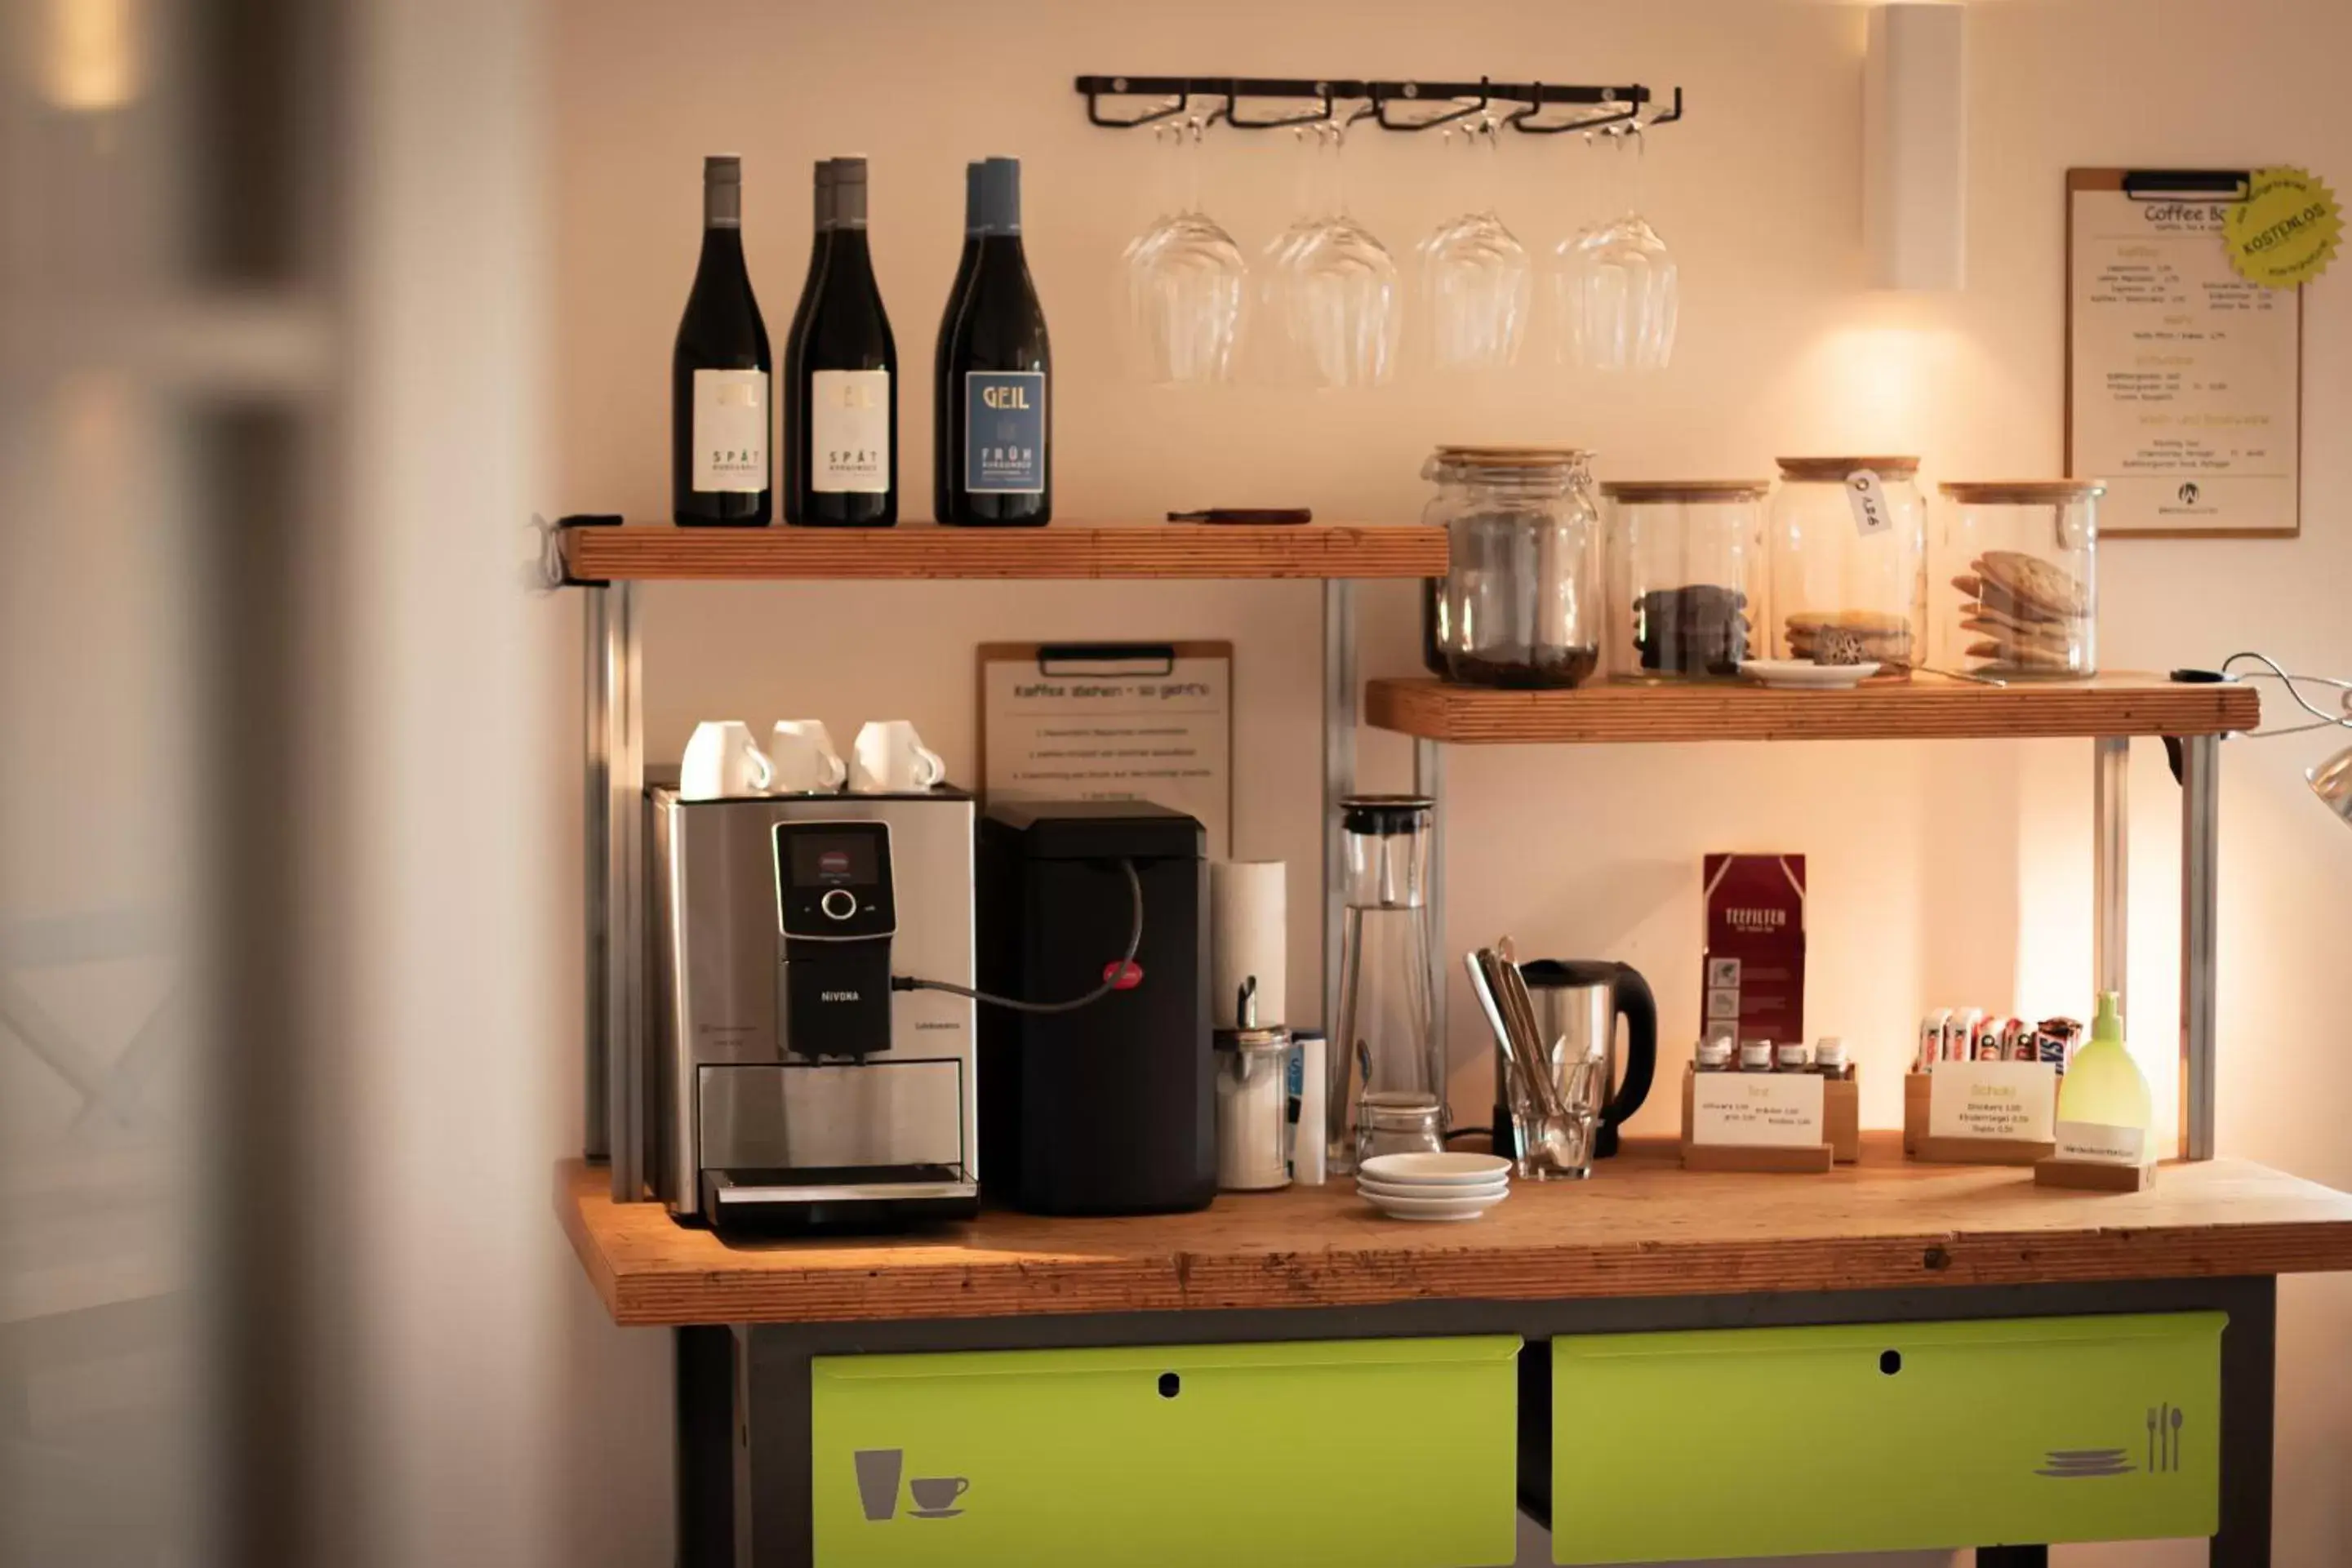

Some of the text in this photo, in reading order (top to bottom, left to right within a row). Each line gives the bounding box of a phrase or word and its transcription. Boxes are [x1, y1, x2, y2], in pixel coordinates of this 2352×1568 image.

[2145, 204, 2204, 222] Coffee
[2210, 205, 2227, 222] Ba
[2242, 202, 2328, 256] KOSTENLOS
[982, 385, 1030, 410] GEIL
[829, 448, 878, 463] SPÄT
[821, 992, 859, 1002] NIVONA
